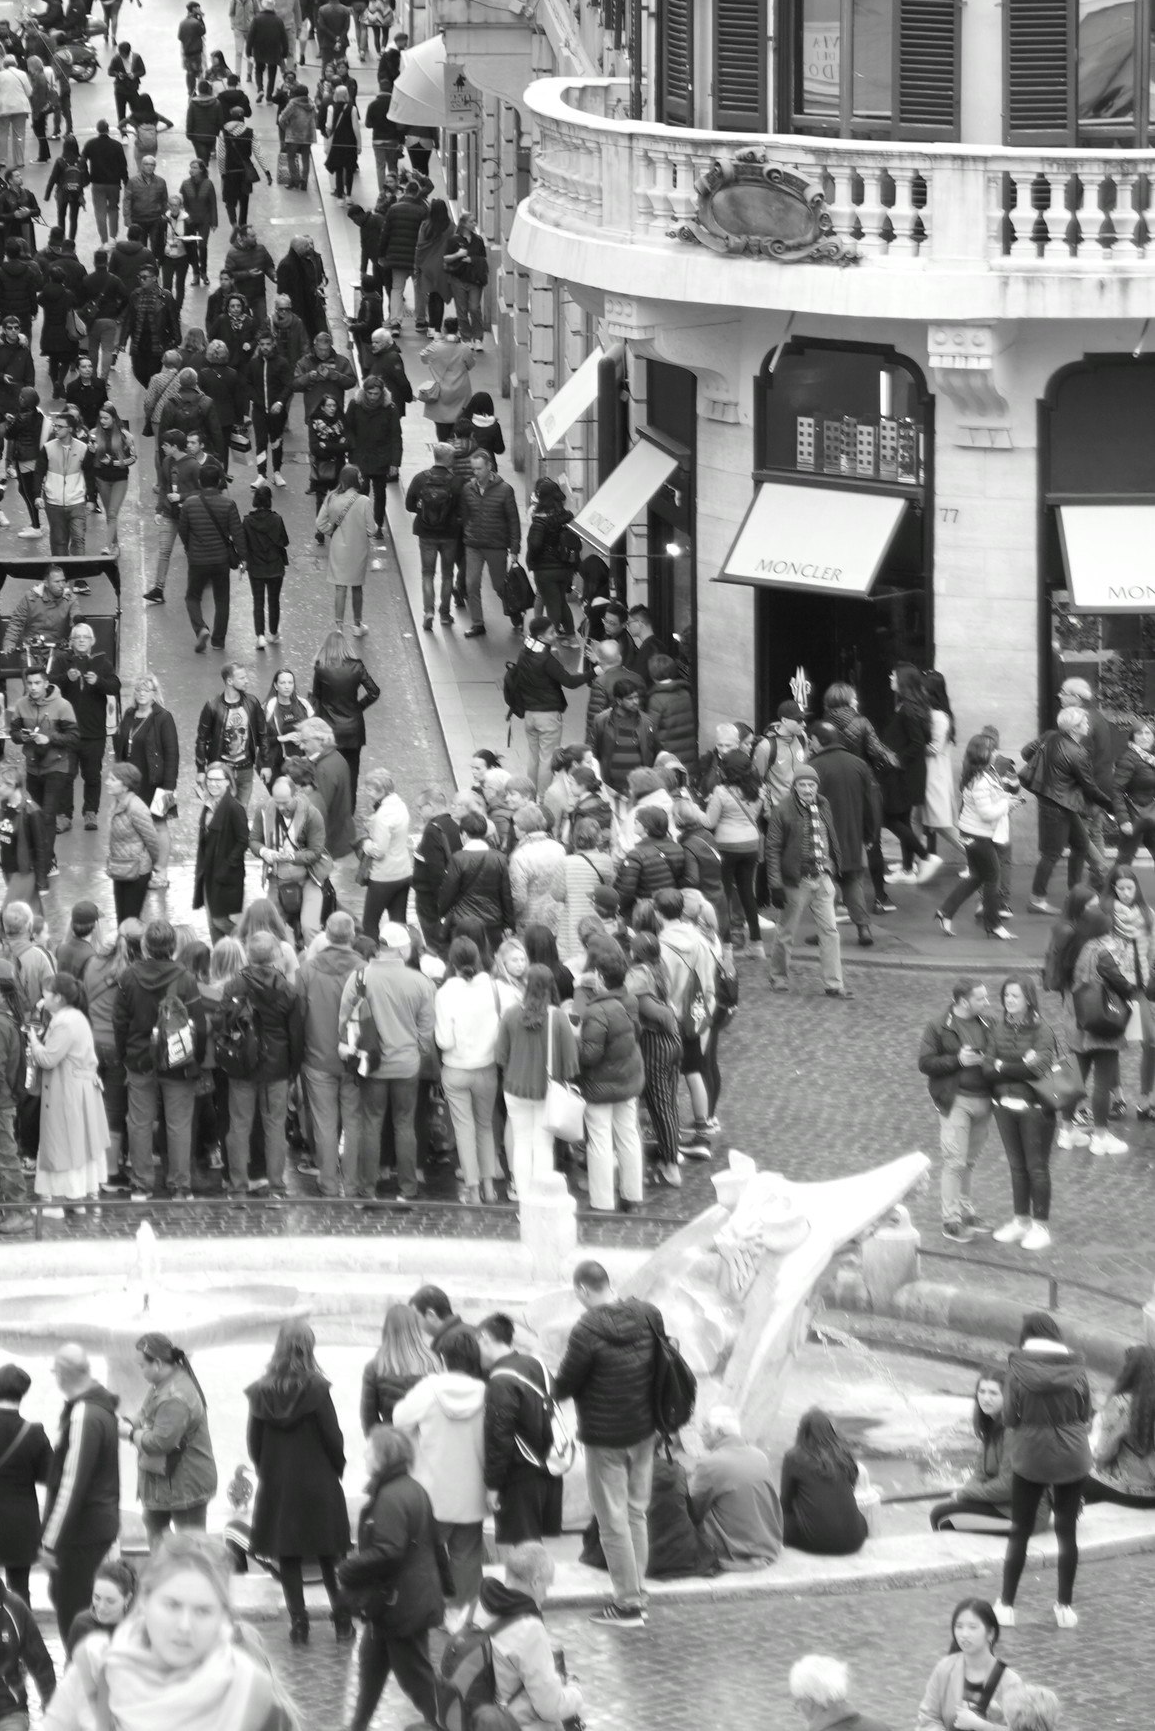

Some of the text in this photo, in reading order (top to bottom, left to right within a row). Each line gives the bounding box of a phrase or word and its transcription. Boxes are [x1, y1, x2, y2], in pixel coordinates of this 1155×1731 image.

[939, 508, 959, 523] 77
[754, 558, 843, 582] MONCLER
[1108, 585, 1155, 599] MON
